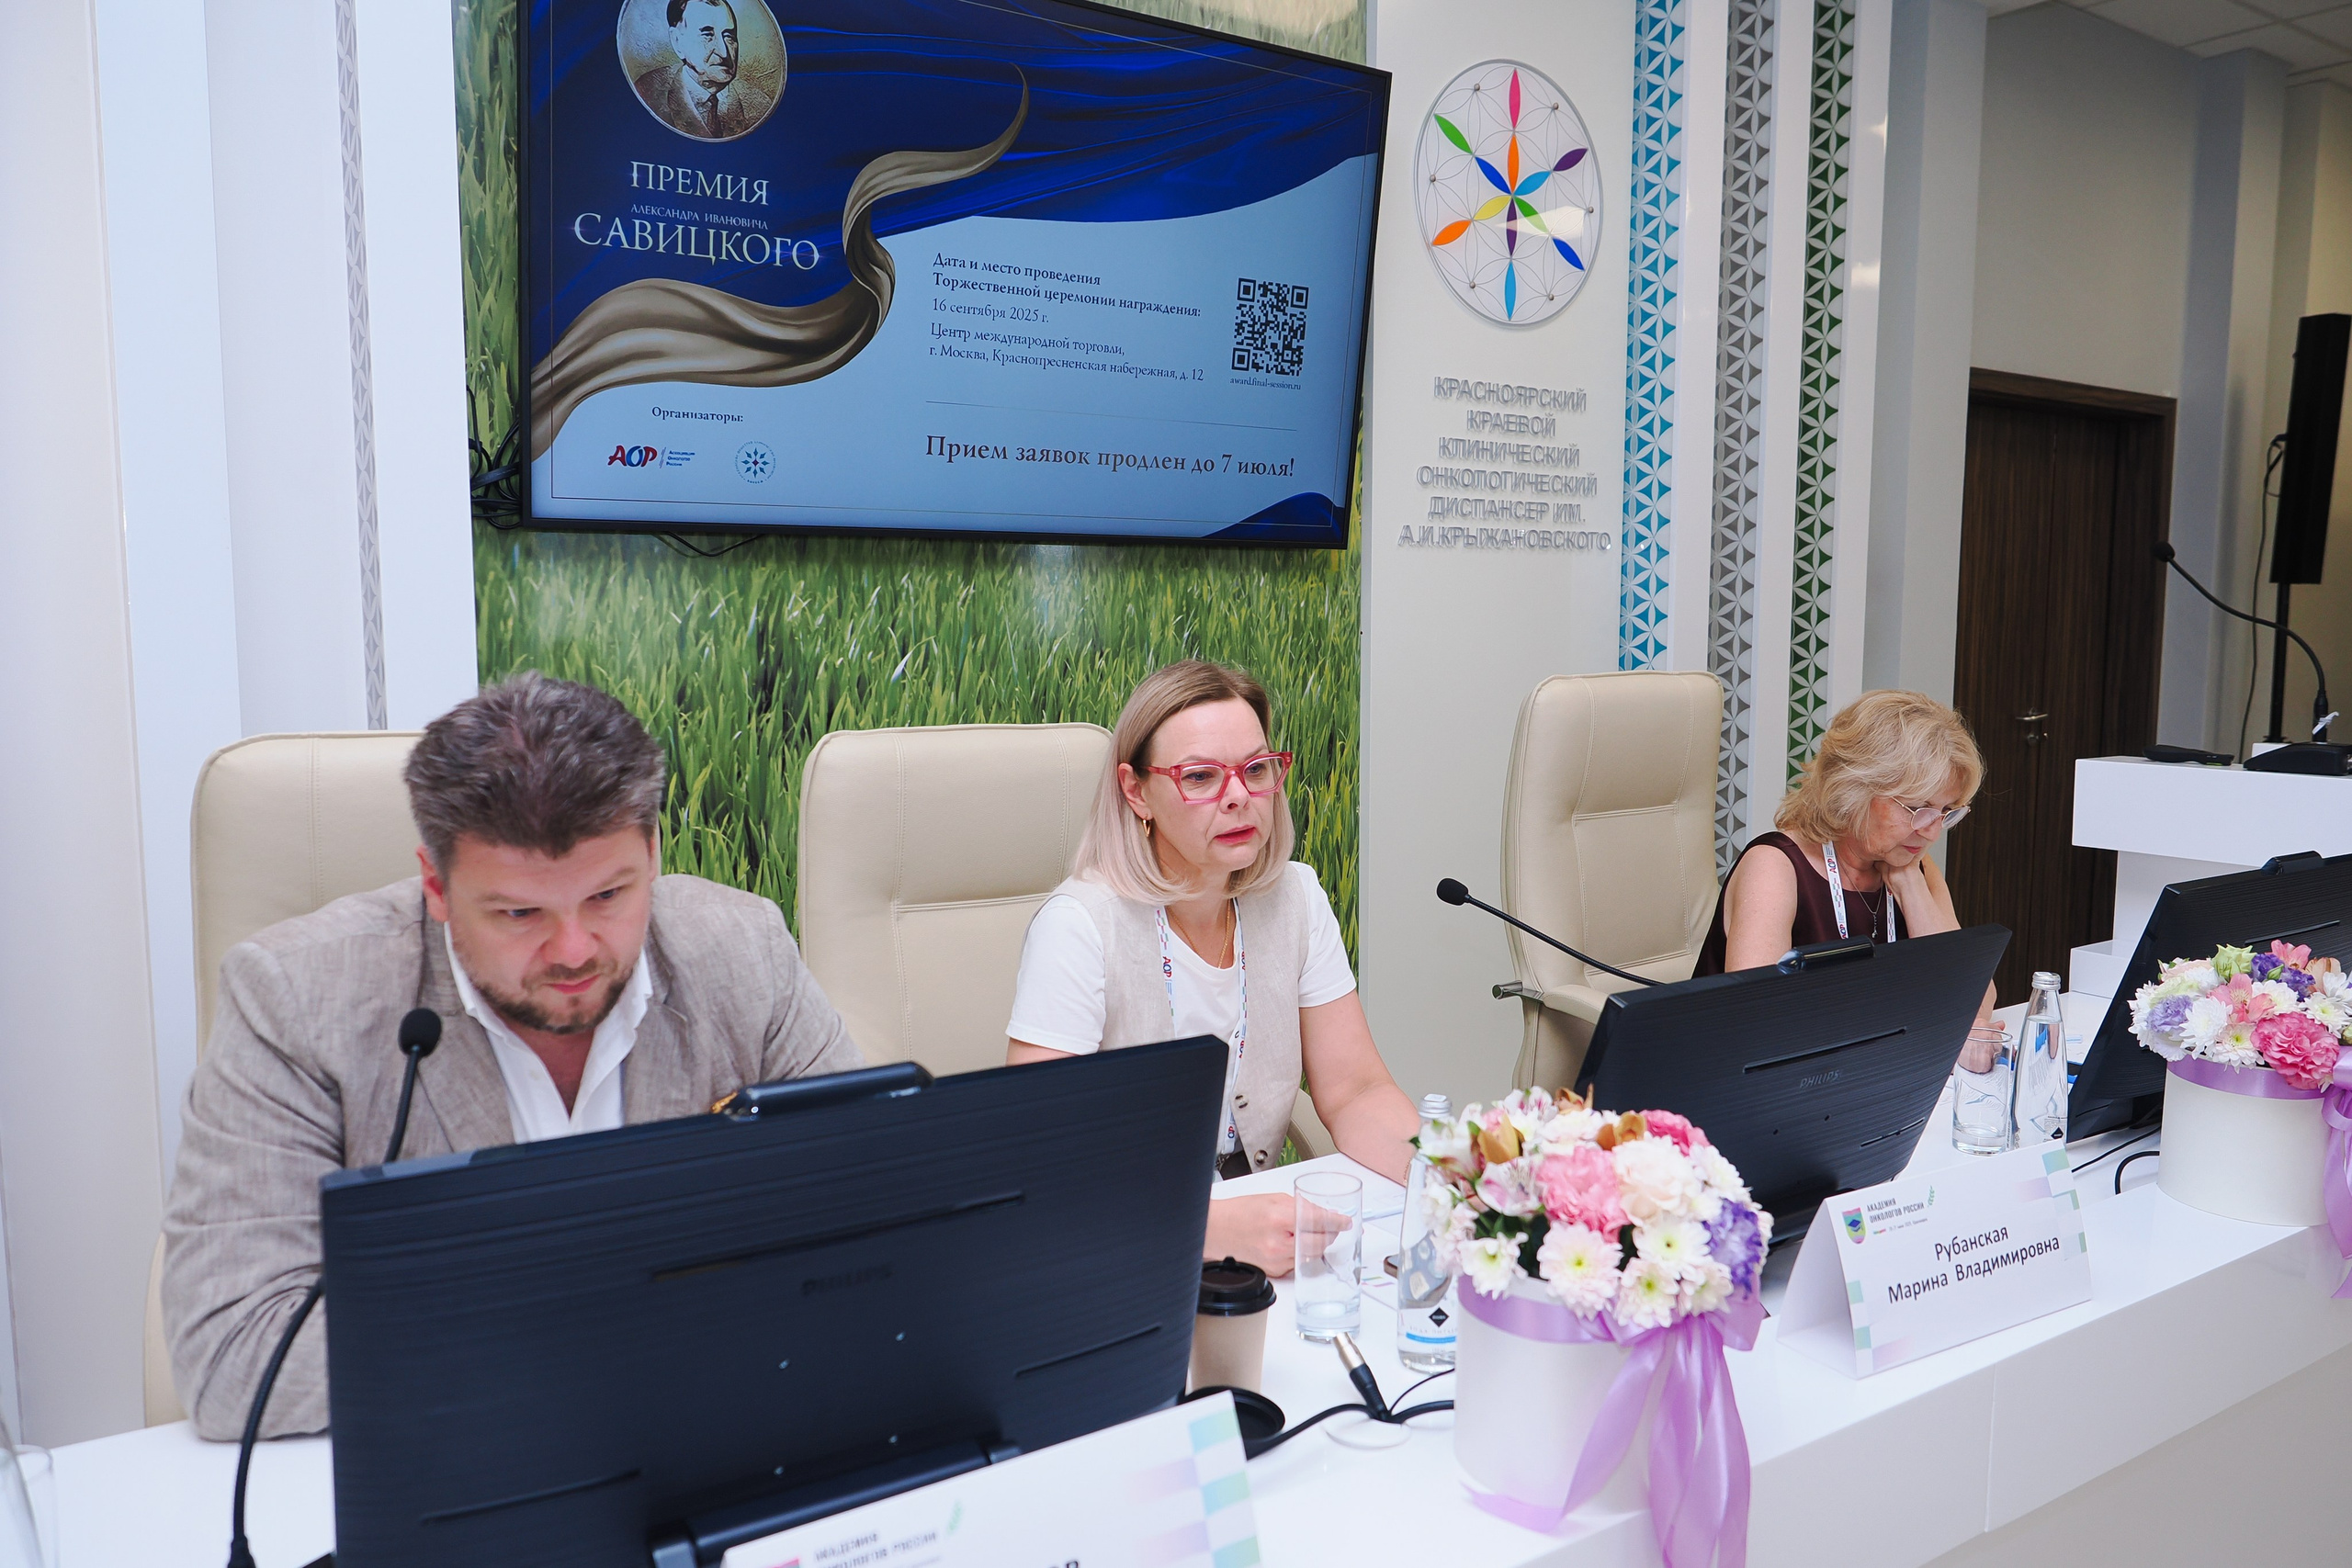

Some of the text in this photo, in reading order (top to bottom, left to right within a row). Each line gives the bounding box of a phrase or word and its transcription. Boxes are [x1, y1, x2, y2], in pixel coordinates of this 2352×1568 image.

[630, 161, 769, 206] ПРЕМИЯ
[630, 204, 768, 230] АЛЕКСАНДРА ИВАНОВИЧА
[574, 212, 820, 270] САВИЦКОГО
[933, 253, 1101, 286] Дата и место проведения
[933, 272, 1201, 317] Торжественной церемонии награждения:
[933, 298, 1049, 322] 16 сентября 2025 г.
[931, 322, 1125, 356] Центр международной торговли,
[930, 344, 1204, 381] г. Москва, Краснопресненская набережная, д. 12
[1433, 376, 1587, 412] КРАСНОЯРСКИЙ
[651, 406, 743, 423] Организаторы:
[1467, 410, 1555, 436] КРАЕВОЙ
[607, 445, 658, 468] АОР
[926, 434, 1295, 477] Прием заявок продлен до 7 июля!
[1439, 436, 1579, 467] КЛИНИЧЕСКИЙ
[1416, 466, 1597, 496] ОНКОЛОГИЧЕСКИЙ
[1428, 496, 1586, 523] ДИСПАНСЕР ИМ.
[1799, 1069, 1840, 1089] PHILIPS
[1867, 1198, 1896, 1213] АКАДЕМИЯ
[1869, 1201, 1925, 1224] ОНКОЛОГОВ РОССИИ
[1935, 1226, 2009, 1262] Рубанская
[1888, 1236, 2060, 1303] Марина Владимировна
